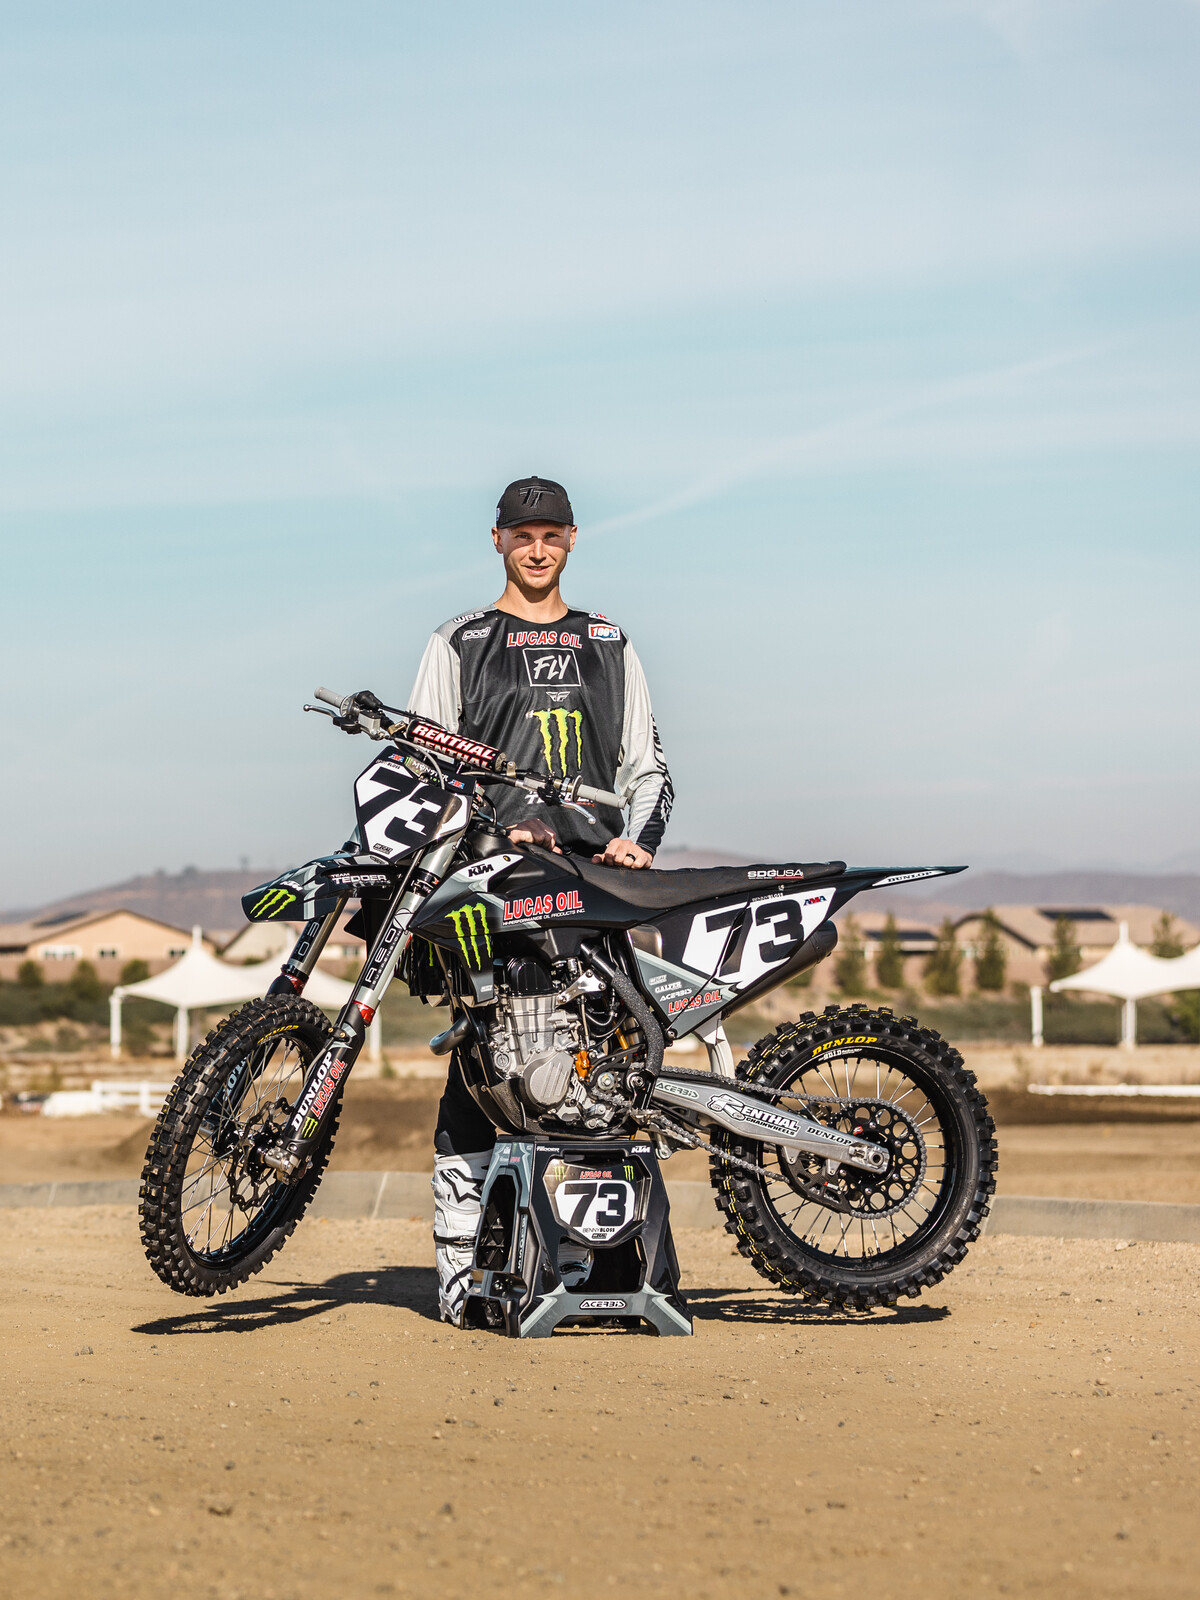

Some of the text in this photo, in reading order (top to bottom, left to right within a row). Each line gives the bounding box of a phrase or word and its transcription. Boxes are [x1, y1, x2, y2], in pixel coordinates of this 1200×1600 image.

[507, 631, 582, 648] LUCAS OIL
[592, 627, 619, 639] 100%
[534, 654, 571, 680] FLY
[412, 724, 497, 760] RENTHAL
[357, 766, 462, 849] 73
[332, 875, 387, 885] TEDDER
[468, 864, 494, 877] KTM
[504, 890, 582, 920] LUCAS OIL
[705, 899, 804, 978] 73
[669, 995, 701, 1013] LUCAS
[704, 989, 721, 1003] OIL
[812, 1036, 877, 1057] DUNLOP
[291, 1051, 332, 1131] DUNLOP
[311, 1058, 345, 1117] LUCAS OIL
[746, 1117, 795, 1136] CHAINWHEELS
[807, 1126, 852, 1145] DUNLOP
[580, 1170, 612, 1178] LUCAS OIL
[564, 1183, 627, 1227] 73
